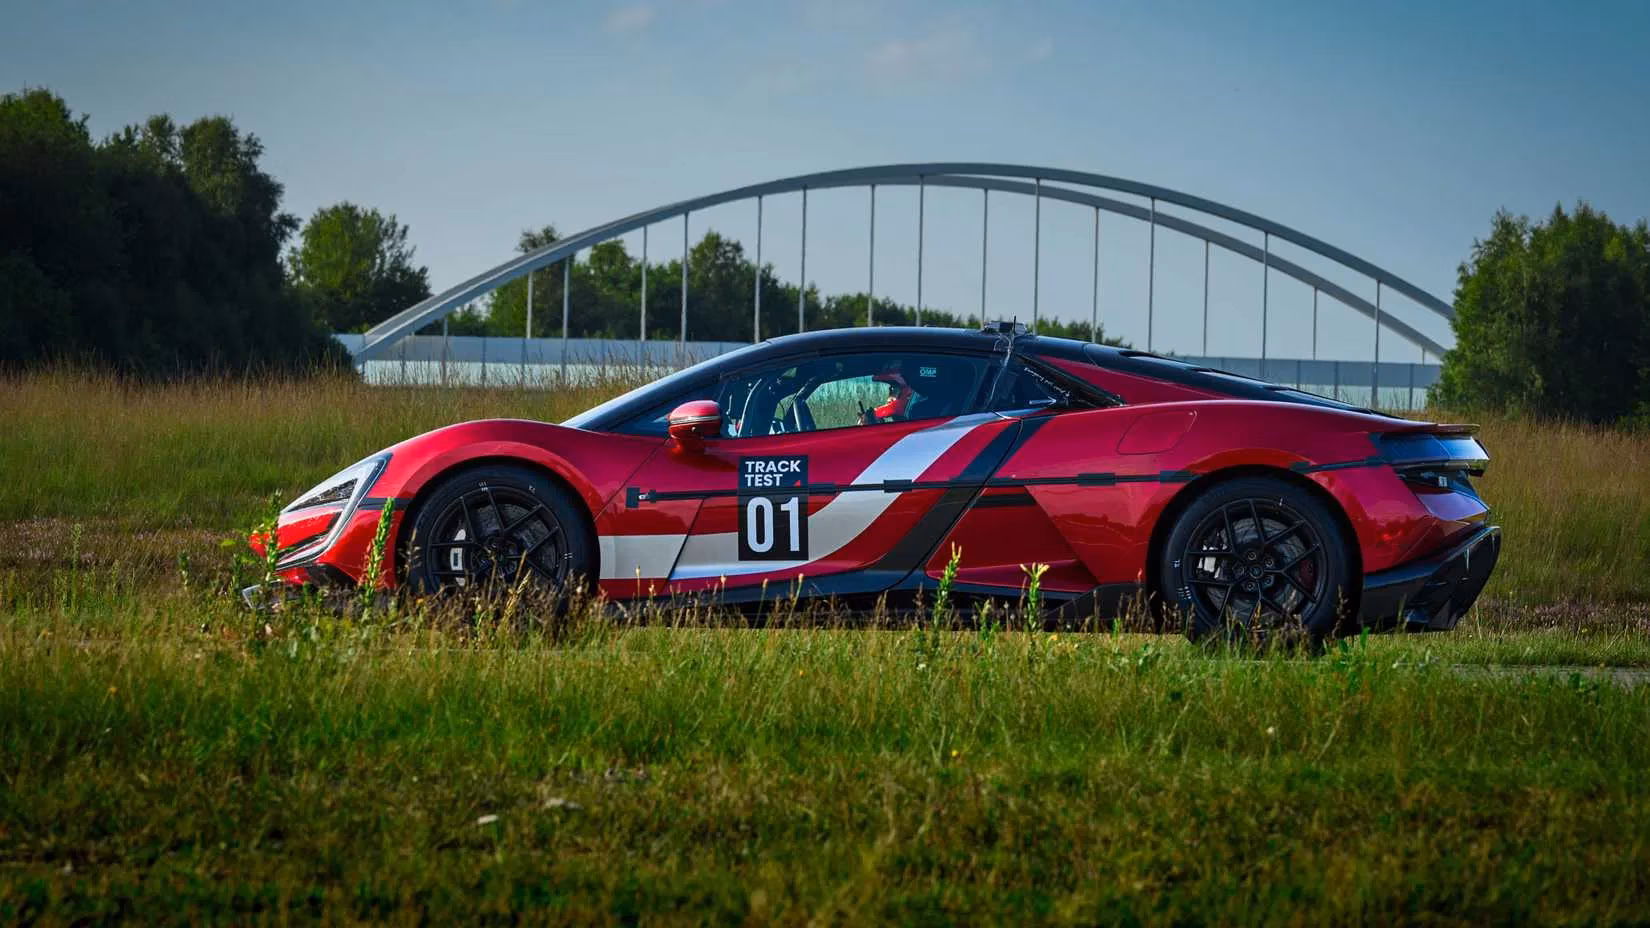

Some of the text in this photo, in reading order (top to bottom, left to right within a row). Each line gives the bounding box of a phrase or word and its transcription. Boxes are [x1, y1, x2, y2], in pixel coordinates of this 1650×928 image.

[745, 460, 801, 473] TRACK
[745, 473, 783, 487] TEST
[746, 496, 800, 553] 01
